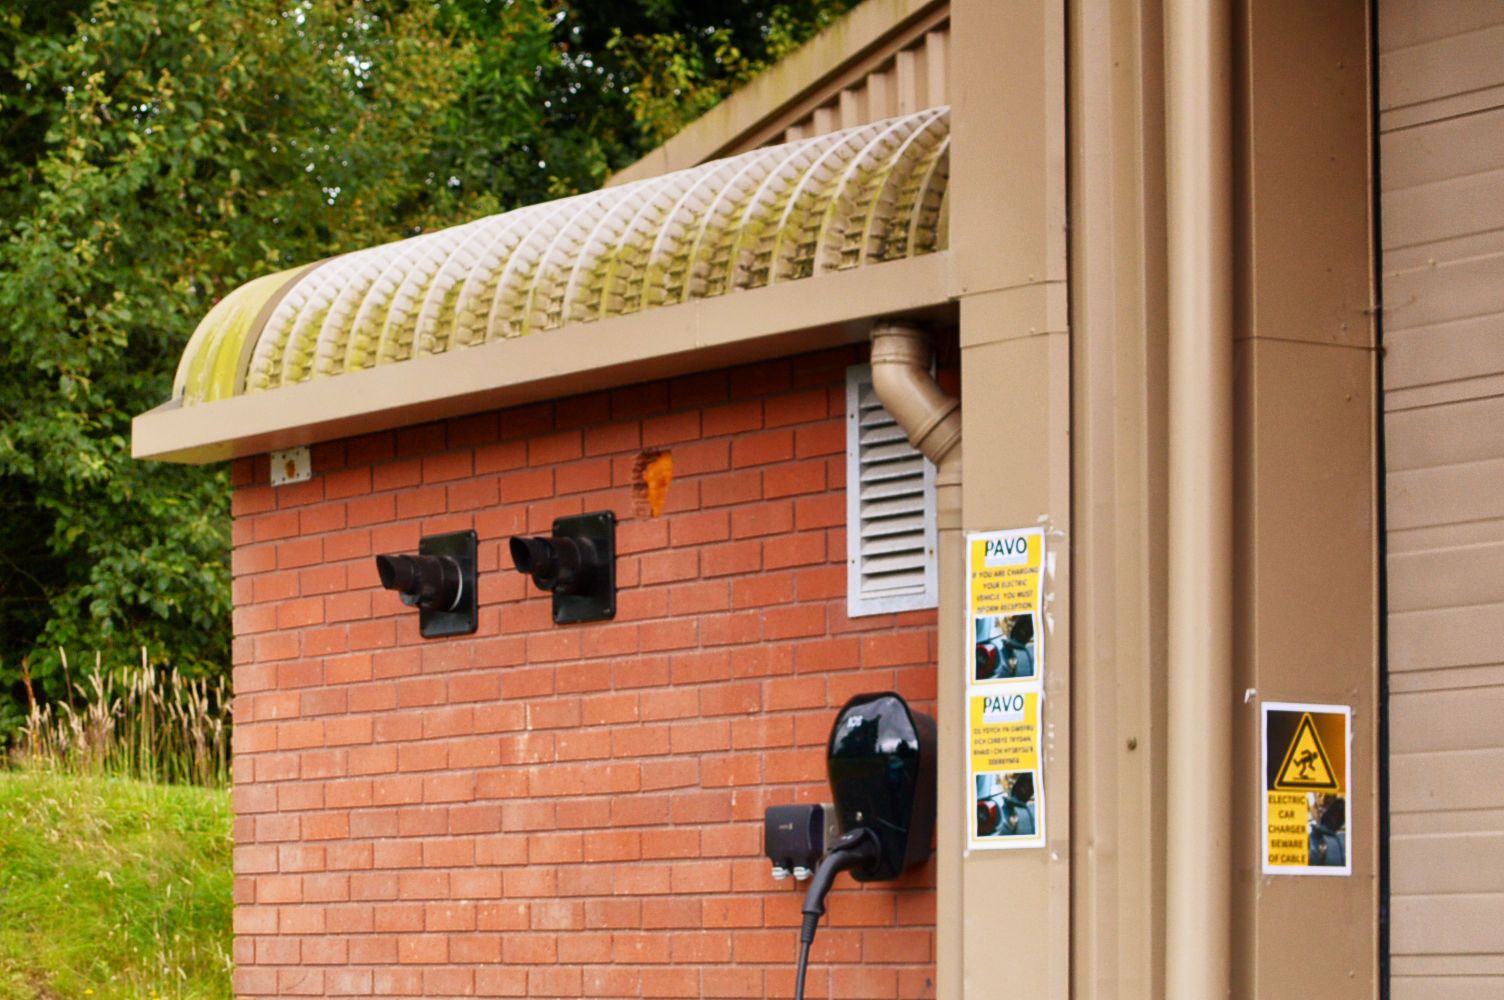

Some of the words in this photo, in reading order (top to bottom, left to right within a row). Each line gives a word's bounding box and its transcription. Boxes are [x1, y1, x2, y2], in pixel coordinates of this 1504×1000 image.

[985, 537, 1028, 556] PAVO
[994, 569, 1005, 577] ARE
[1007, 567, 1038, 576] CHARGING
[1001, 579, 1027, 588] ELECTRIC
[983, 694, 1024, 713] PAVO
[1268, 794, 1305, 805] ELECTRIC
[1278, 809, 1295, 819] CAR
[1268, 825, 1306, 833] CHARGER
[1271, 839, 1303, 848] BEWARE
[1268, 854, 1278, 862] OF
[1280, 854, 1305, 863] CABLE
